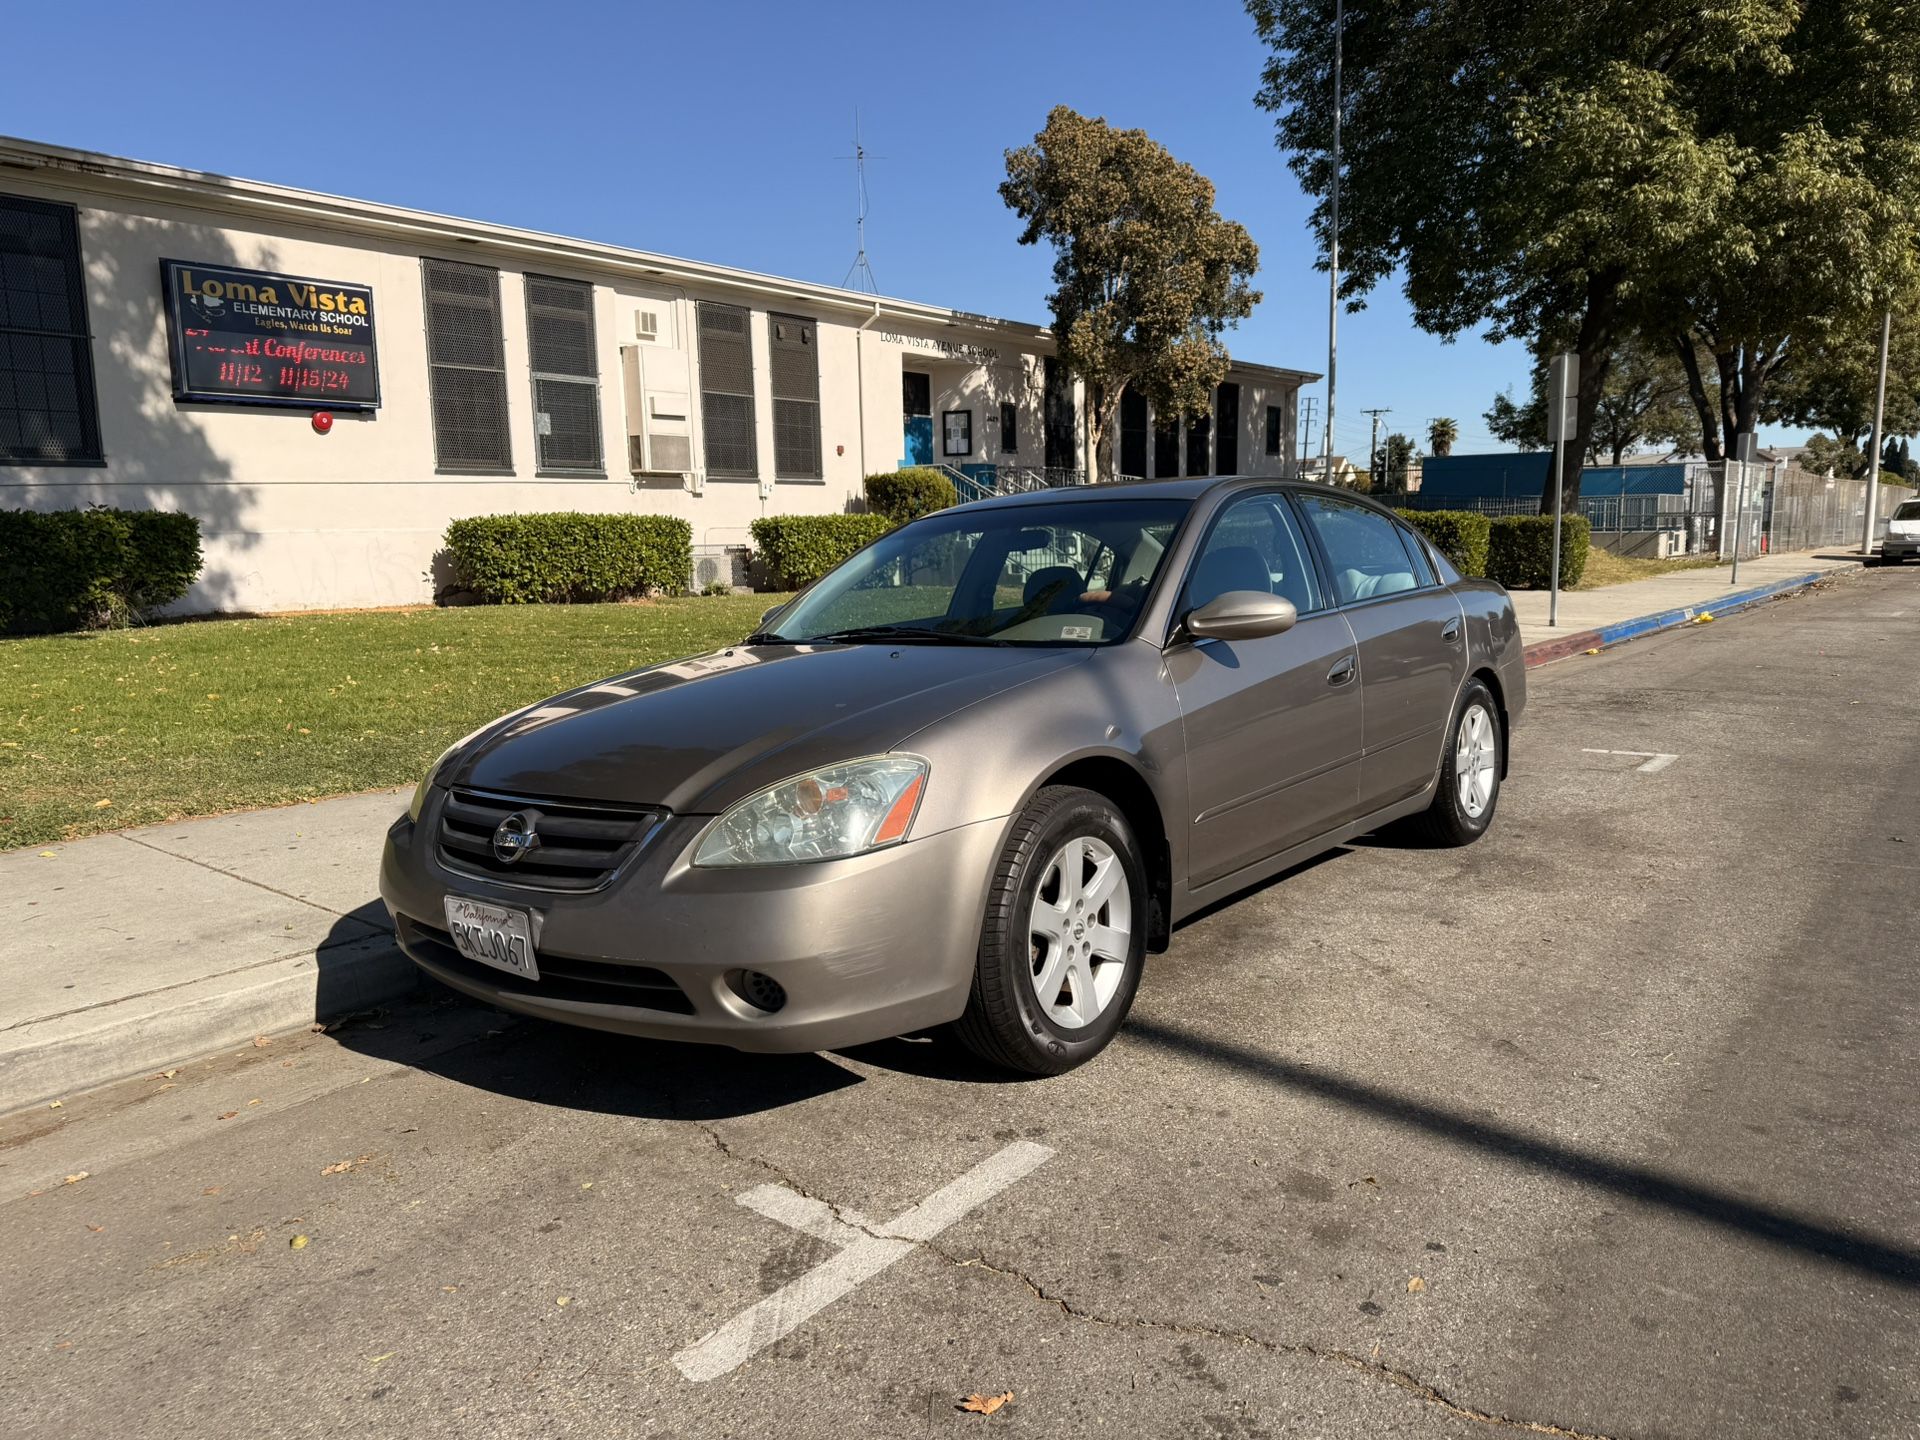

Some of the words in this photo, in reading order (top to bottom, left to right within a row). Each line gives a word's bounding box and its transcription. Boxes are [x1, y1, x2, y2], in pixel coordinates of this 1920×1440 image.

[182, 270, 279, 304] Loma
[287, 283, 367, 314] Vista
[233, 302, 316, 320] ELEMENTARY
[320, 311, 369, 327] SCHOOL
[255, 317, 288, 330] Eagles,
[290, 321, 318, 332] Watch
[320, 323, 332, 333] Us
[333, 325, 352, 336] Soar
[264, 339, 366, 364] Conferences
[881, 331, 903, 344] LOMA
[907, 335, 930, 348] VISTA
[932, 339, 964, 354] AVENUE
[968, 345, 999, 358] SCHOOL
[219, 363, 264, 385] 11/12
[280, 367, 349, 391] 11/15/24
[463, 903, 512, 926] California
